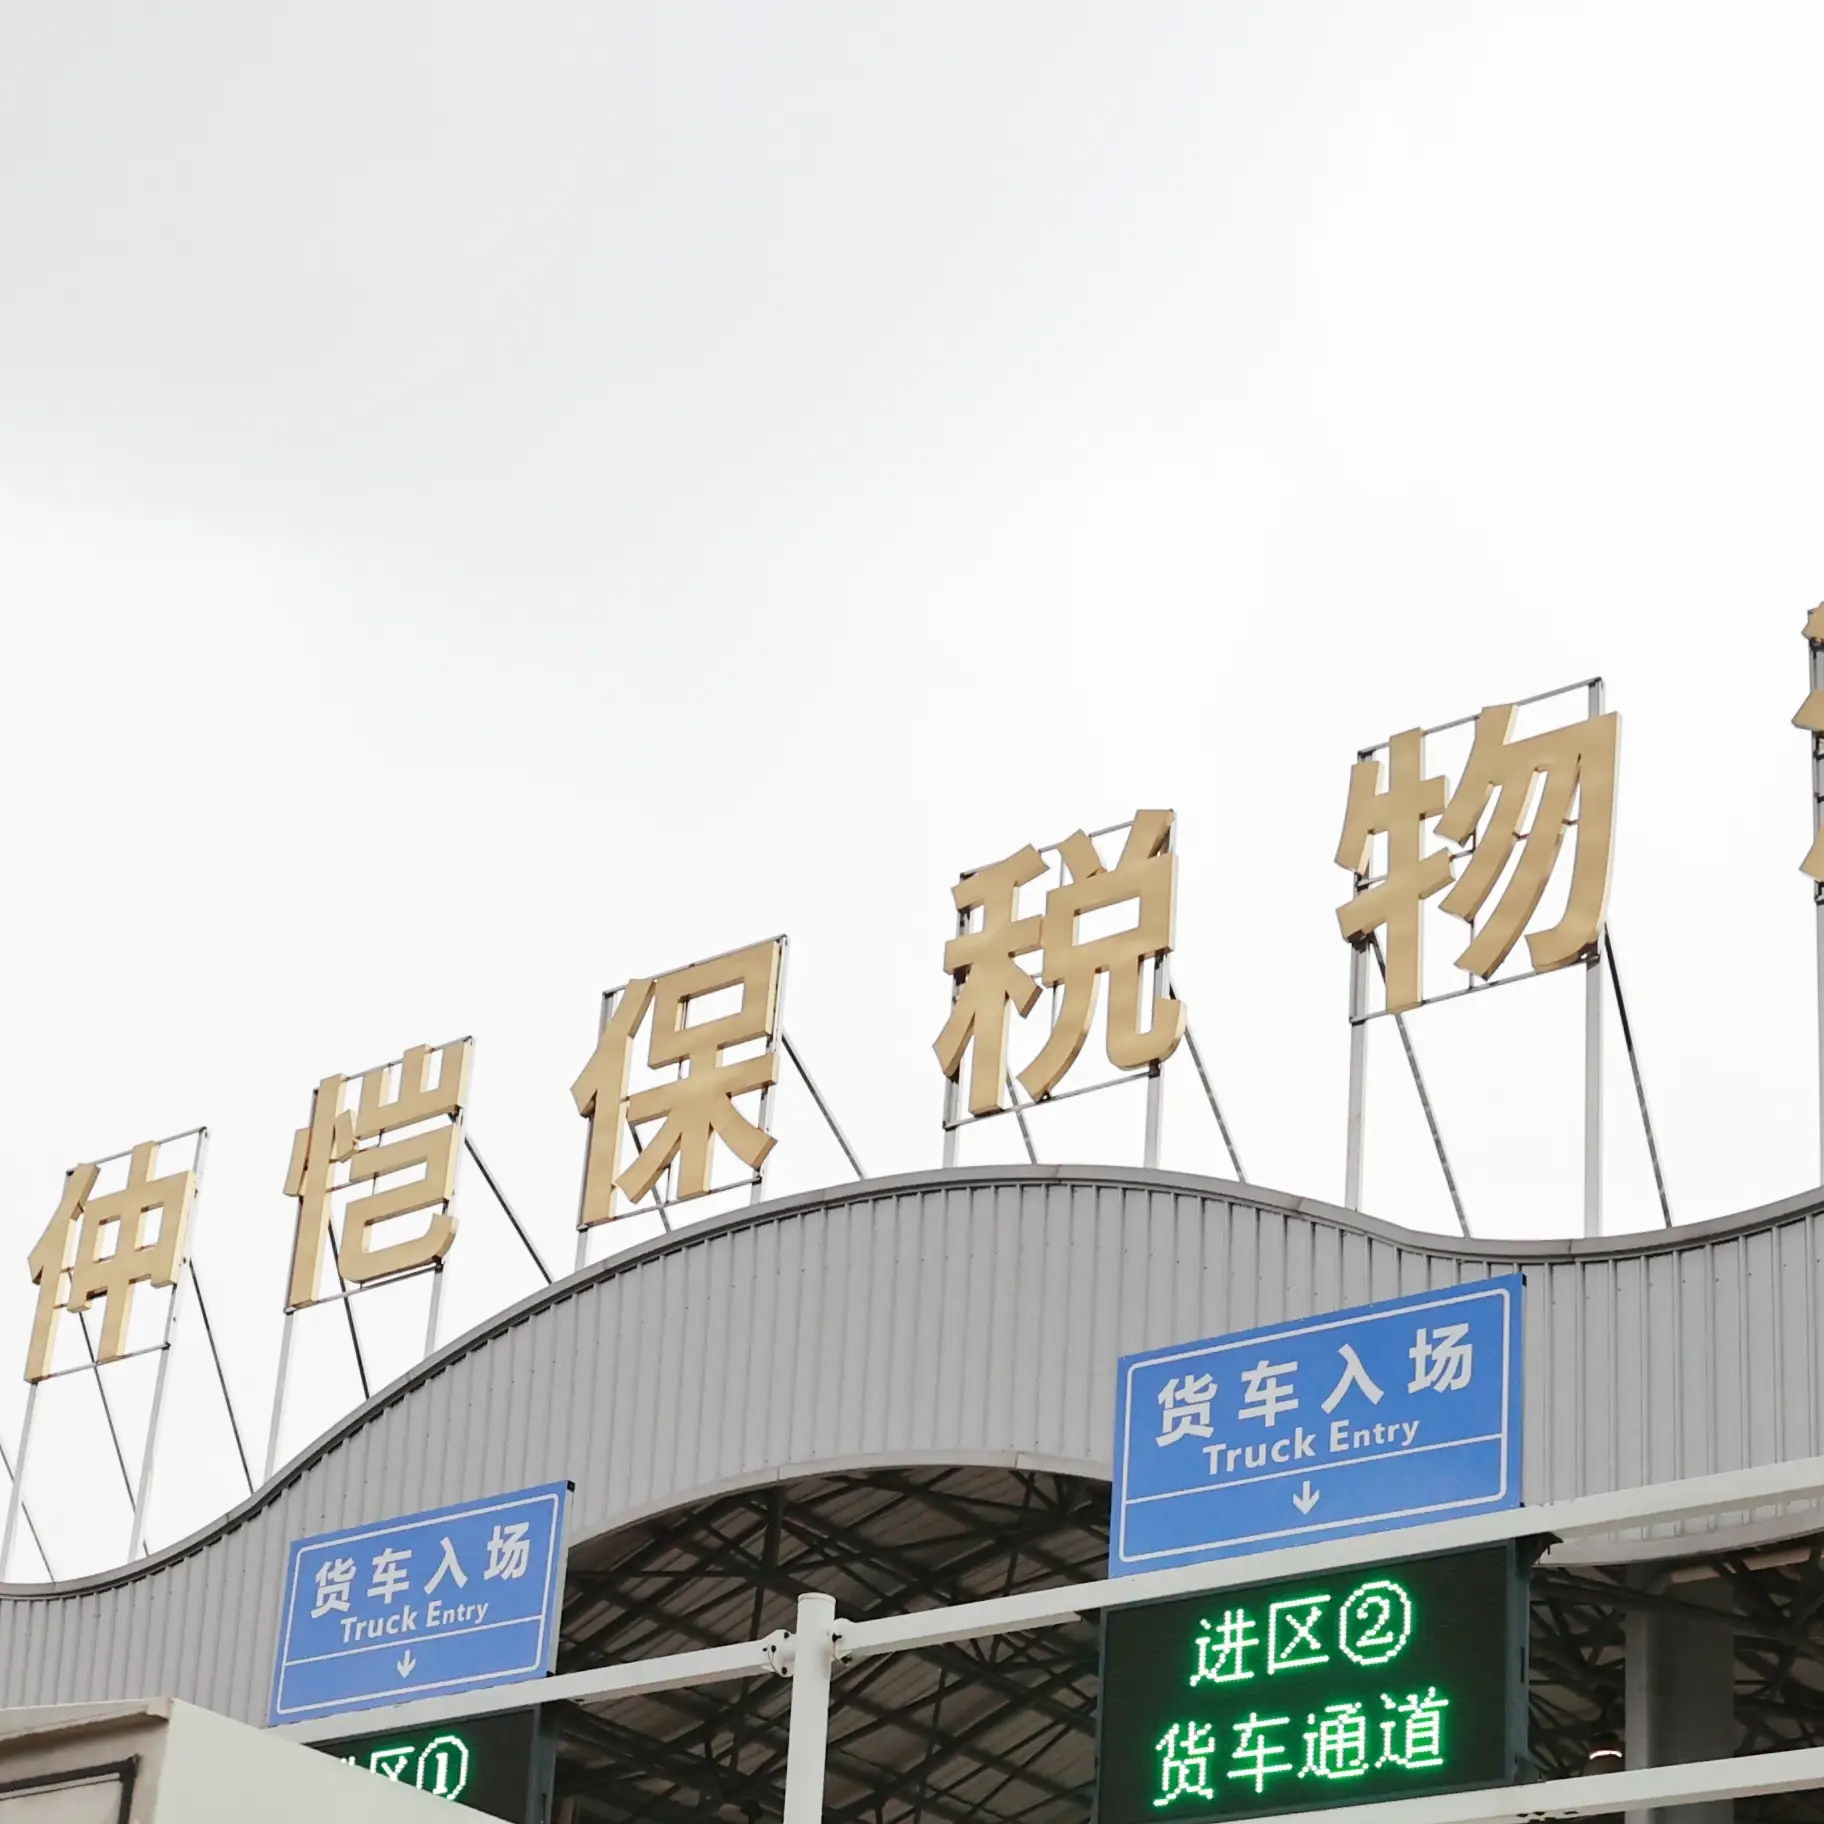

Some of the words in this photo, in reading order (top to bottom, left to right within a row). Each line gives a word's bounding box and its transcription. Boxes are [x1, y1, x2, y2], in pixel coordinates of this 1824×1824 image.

[1155, 1323, 1472, 1446] 货车入场
[1203, 1427, 1316, 1475] Truck
[1330, 1417, 1420, 1453] Entry
[310, 1522, 530, 1619] 货车入场
[341, 1605, 416, 1643] Truck
[426, 1600, 489, 1628] Entry
[1154, 1687, 1449, 1807] 货车通道
